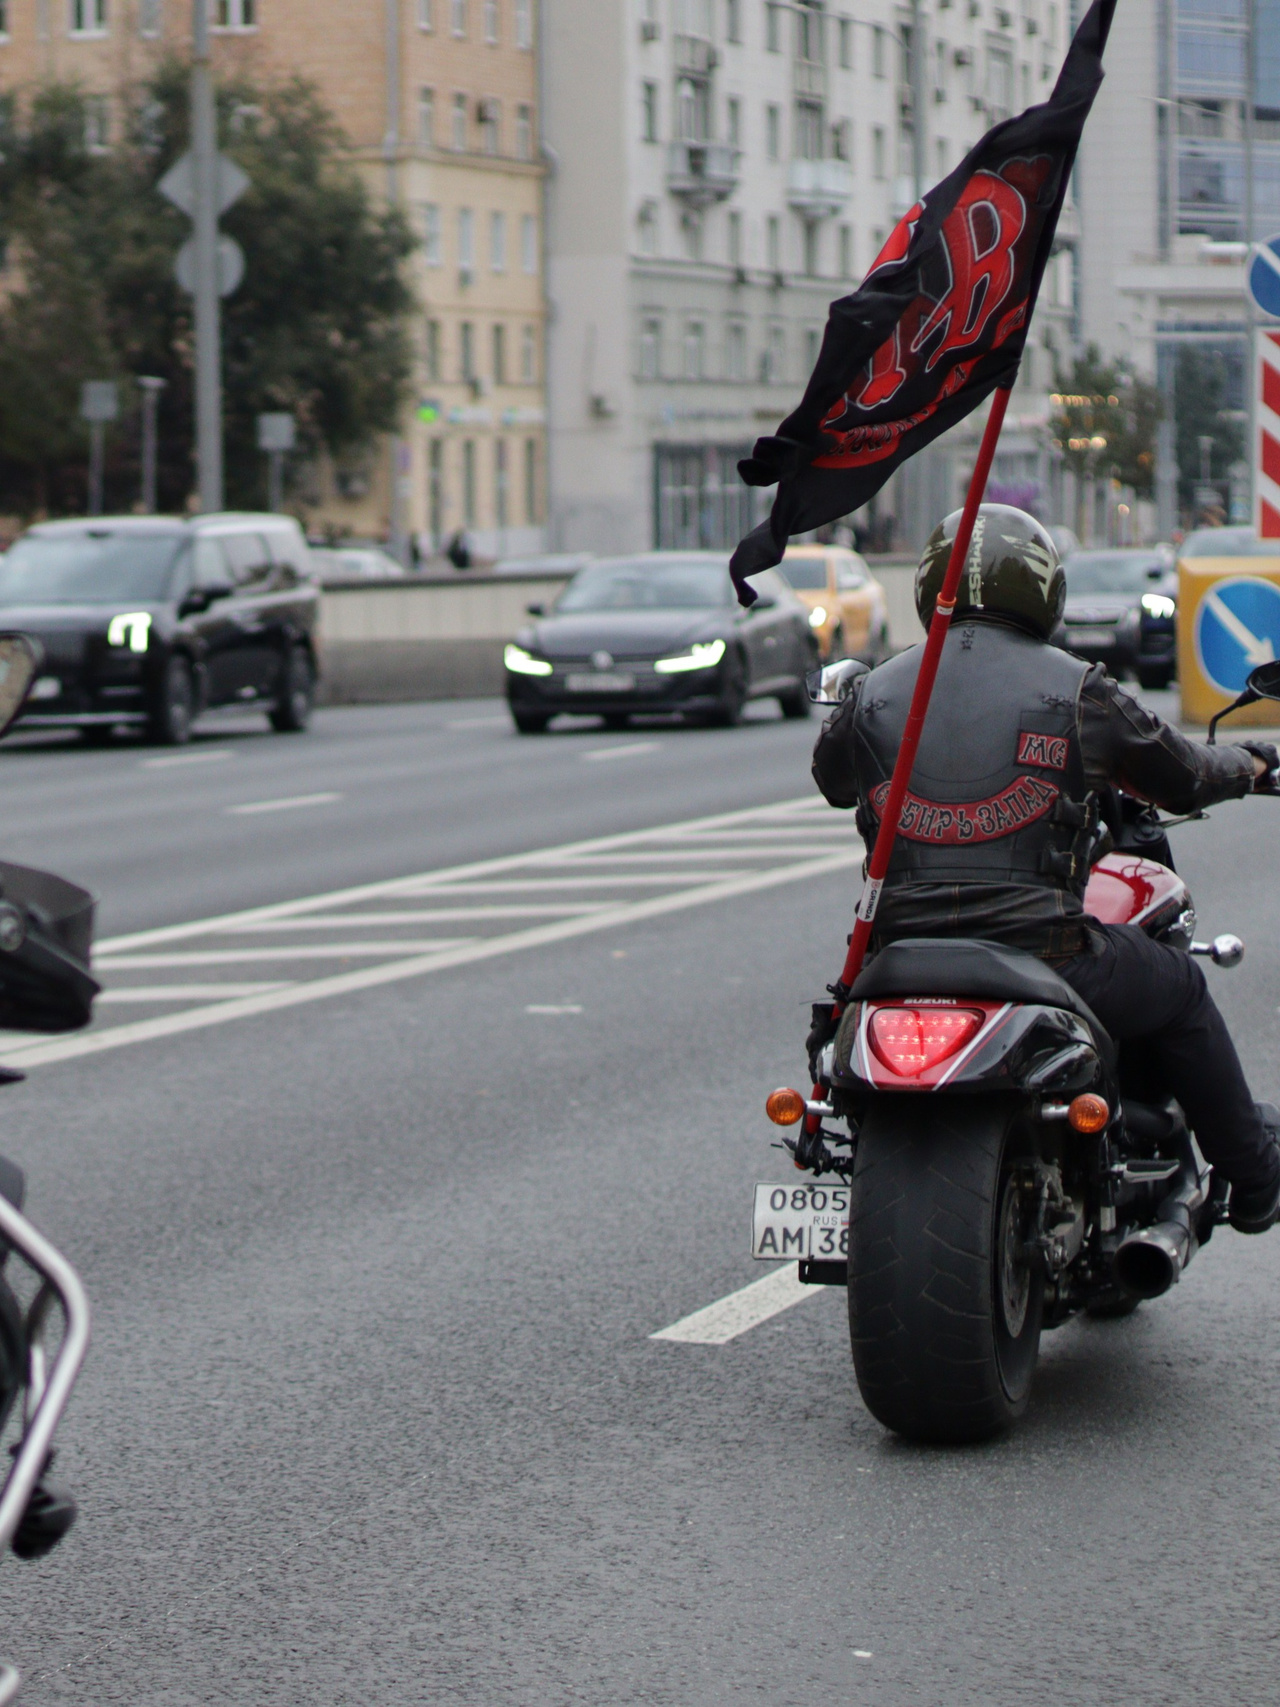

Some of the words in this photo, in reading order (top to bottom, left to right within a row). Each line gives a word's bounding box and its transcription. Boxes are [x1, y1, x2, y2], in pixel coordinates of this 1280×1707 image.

[864, 889, 878, 920] GRINDA
[770, 1188, 847, 1212] 0805
[813, 1215, 838, 1226] RUS
[758, 1227, 803, 1253] AM
